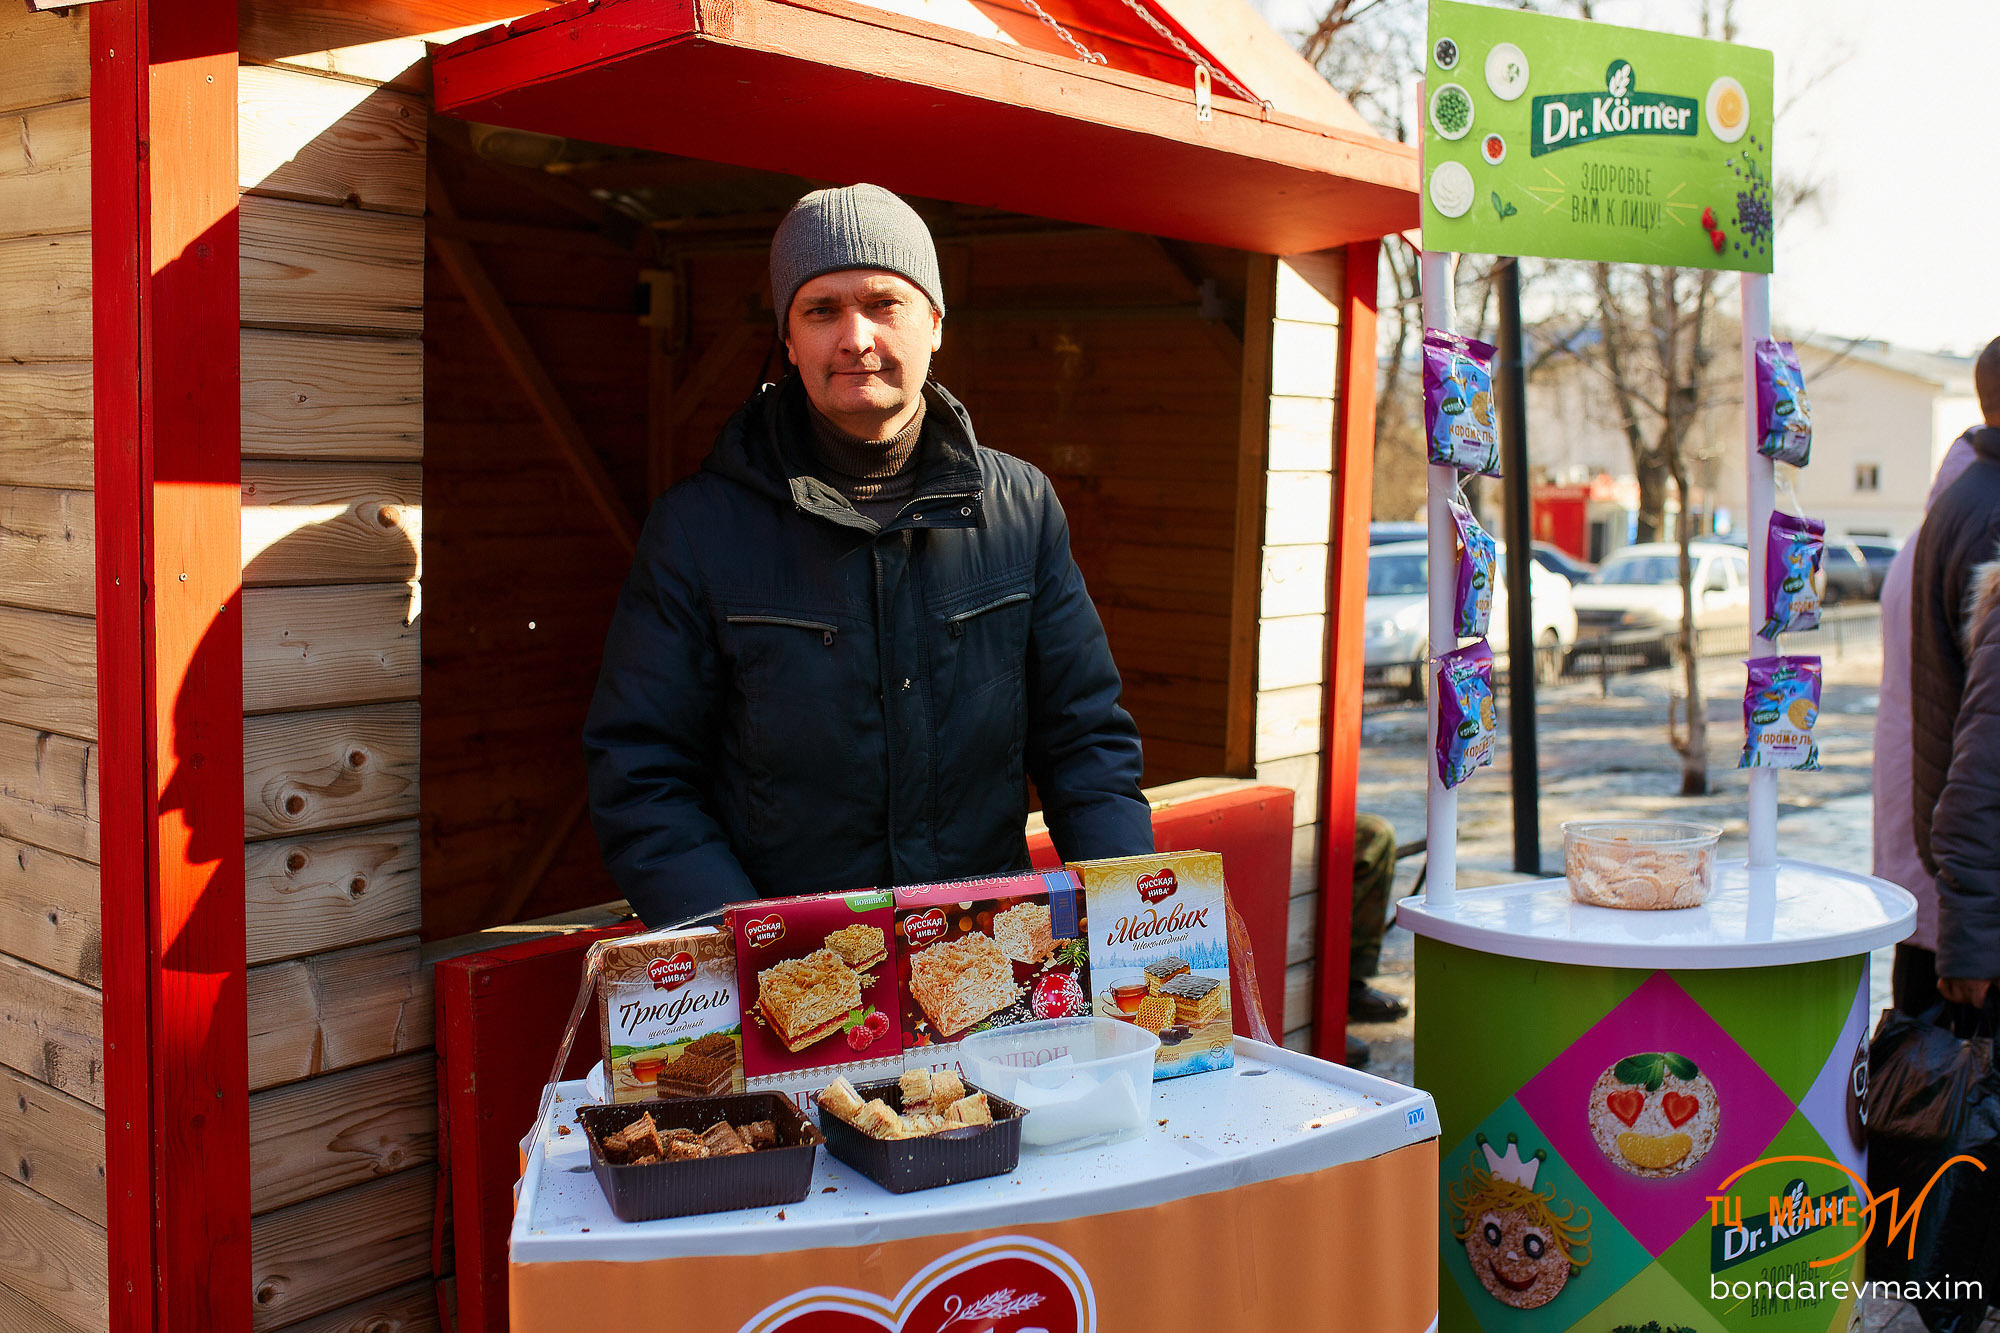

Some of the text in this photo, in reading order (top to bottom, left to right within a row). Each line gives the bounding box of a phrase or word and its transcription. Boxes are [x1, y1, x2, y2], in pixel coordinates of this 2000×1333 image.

[1543, 97, 1691, 145] Dr. Körner
[1581, 162, 1653, 197] ЗДОРОВЬЕ
[1571, 194, 1661, 234] ВАМ К ЛИЦУ!
[1757, 733, 1813, 745] карамель
[1138, 876, 1173, 891] РУССКАЯ
[854, 894, 888, 906] НОВИНКА
[1147, 888, 1168, 898] НИВА
[748, 922, 781, 936] РУССКАЯ
[907, 917, 943, 932] РУССКАЯ
[1106, 903, 1209, 946] Медовик
[756, 932, 776, 942] НИВА
[916, 928, 937, 939] НИВА
[1132, 932, 1190, 951] Шоколадный
[650, 961, 692, 978] РУССКАЯ
[661, 973, 686, 985] НИВА
[619, 988, 730, 1036] Трюфель
[648, 1018, 704, 1040] шоколадный
[1723, 1224, 1767, 1261] Dr.
[1751, 1293, 1778, 1318] ВАМ
